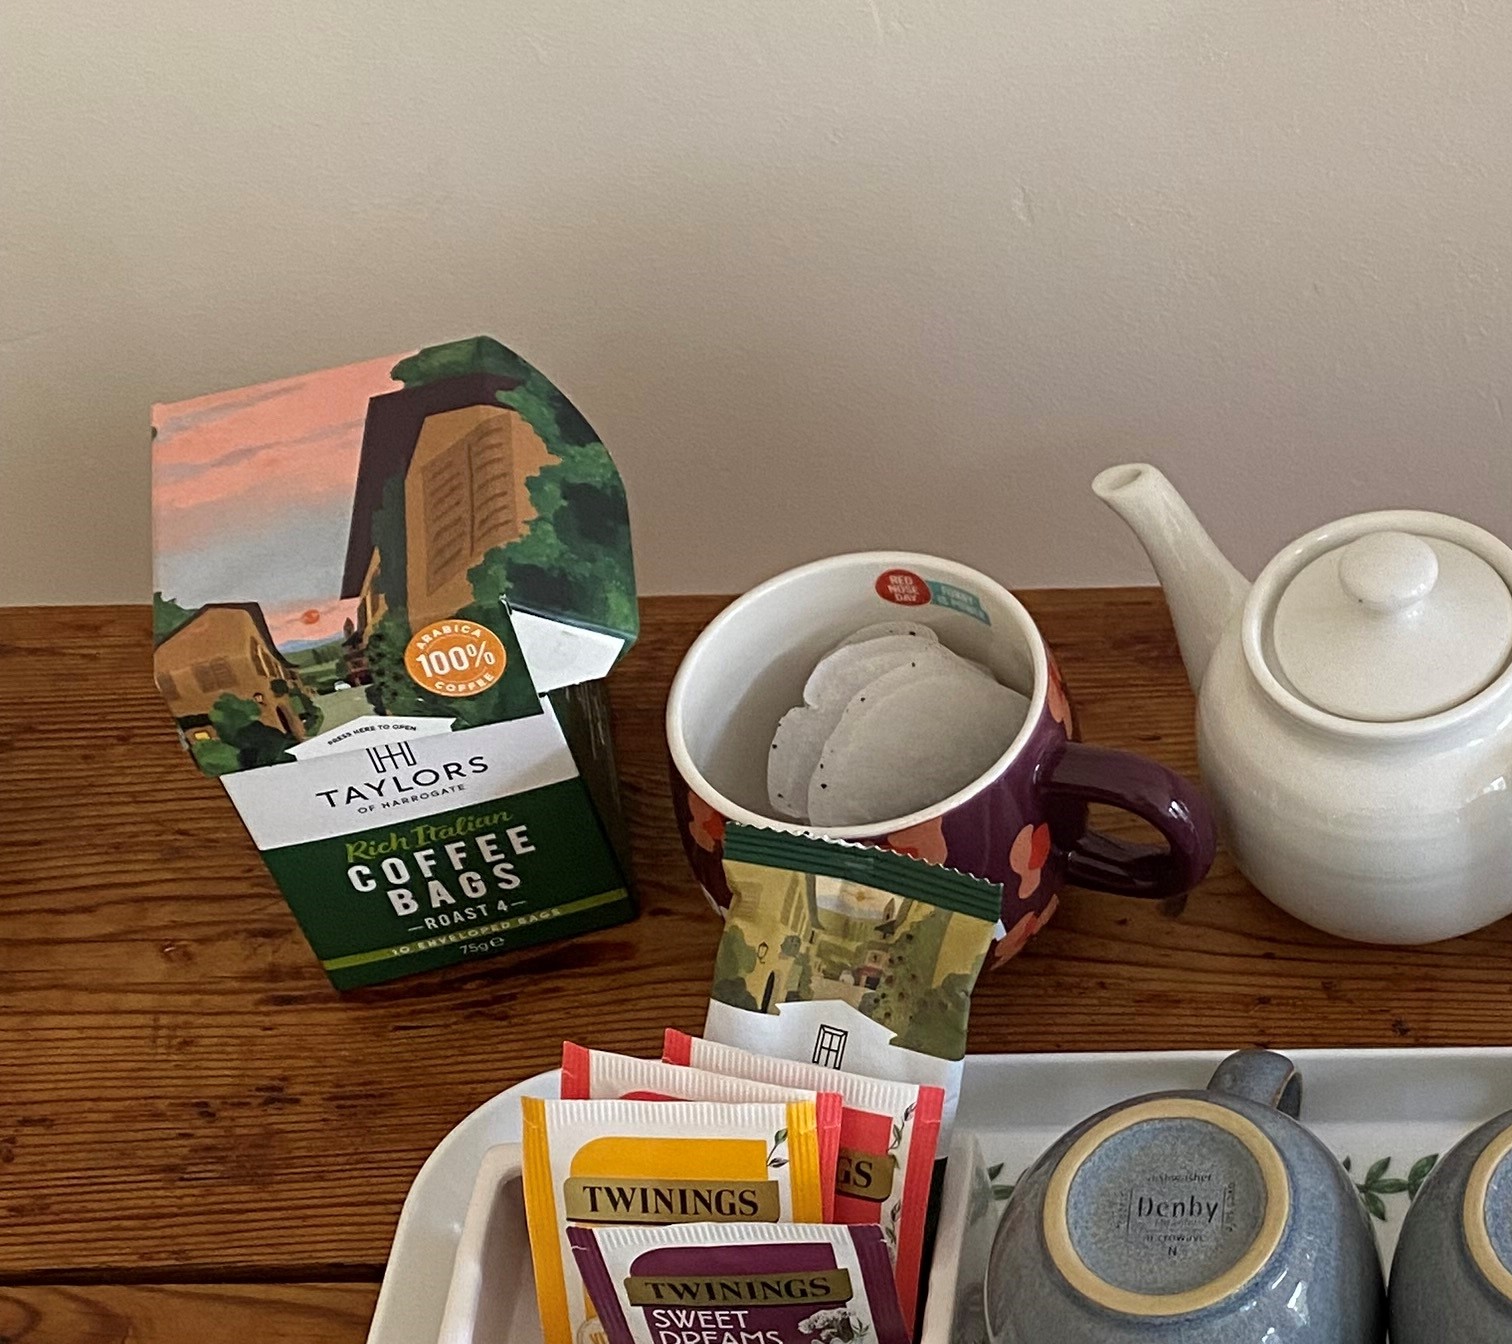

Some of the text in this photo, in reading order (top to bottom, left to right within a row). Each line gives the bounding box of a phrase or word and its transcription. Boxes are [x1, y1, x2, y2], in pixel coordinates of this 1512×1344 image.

[888, 575, 914, 585] RED
[894, 593, 917, 602] DAY
[416, 624, 482, 650] ARABICA
[415, 640, 496, 678] 100%
[434, 672, 495, 692] COFFEE
[327, 732, 352, 746] PRESS
[352, 724, 376, 736] HERE
[392, 724, 418, 732] OPEN
[315, 755, 489, 808] TAYLORS
[357, 783, 466, 815] OF HARROGATE
[345, 810, 514, 863] Rich Italian
[347, 824, 536, 893] COFFEE
[386, 862, 521, 917] BAGS
[423, 899, 508, 931] ROAST 4
[391, 908, 561, 956] 10 ENVELOPED BAGS
[582, 1184, 759, 1217] TWININGS
[1137, 1195, 1219, 1224] Denby
[644, 1276, 831, 1302] TWININGS
[652, 1308, 749, 1329] SWEET
